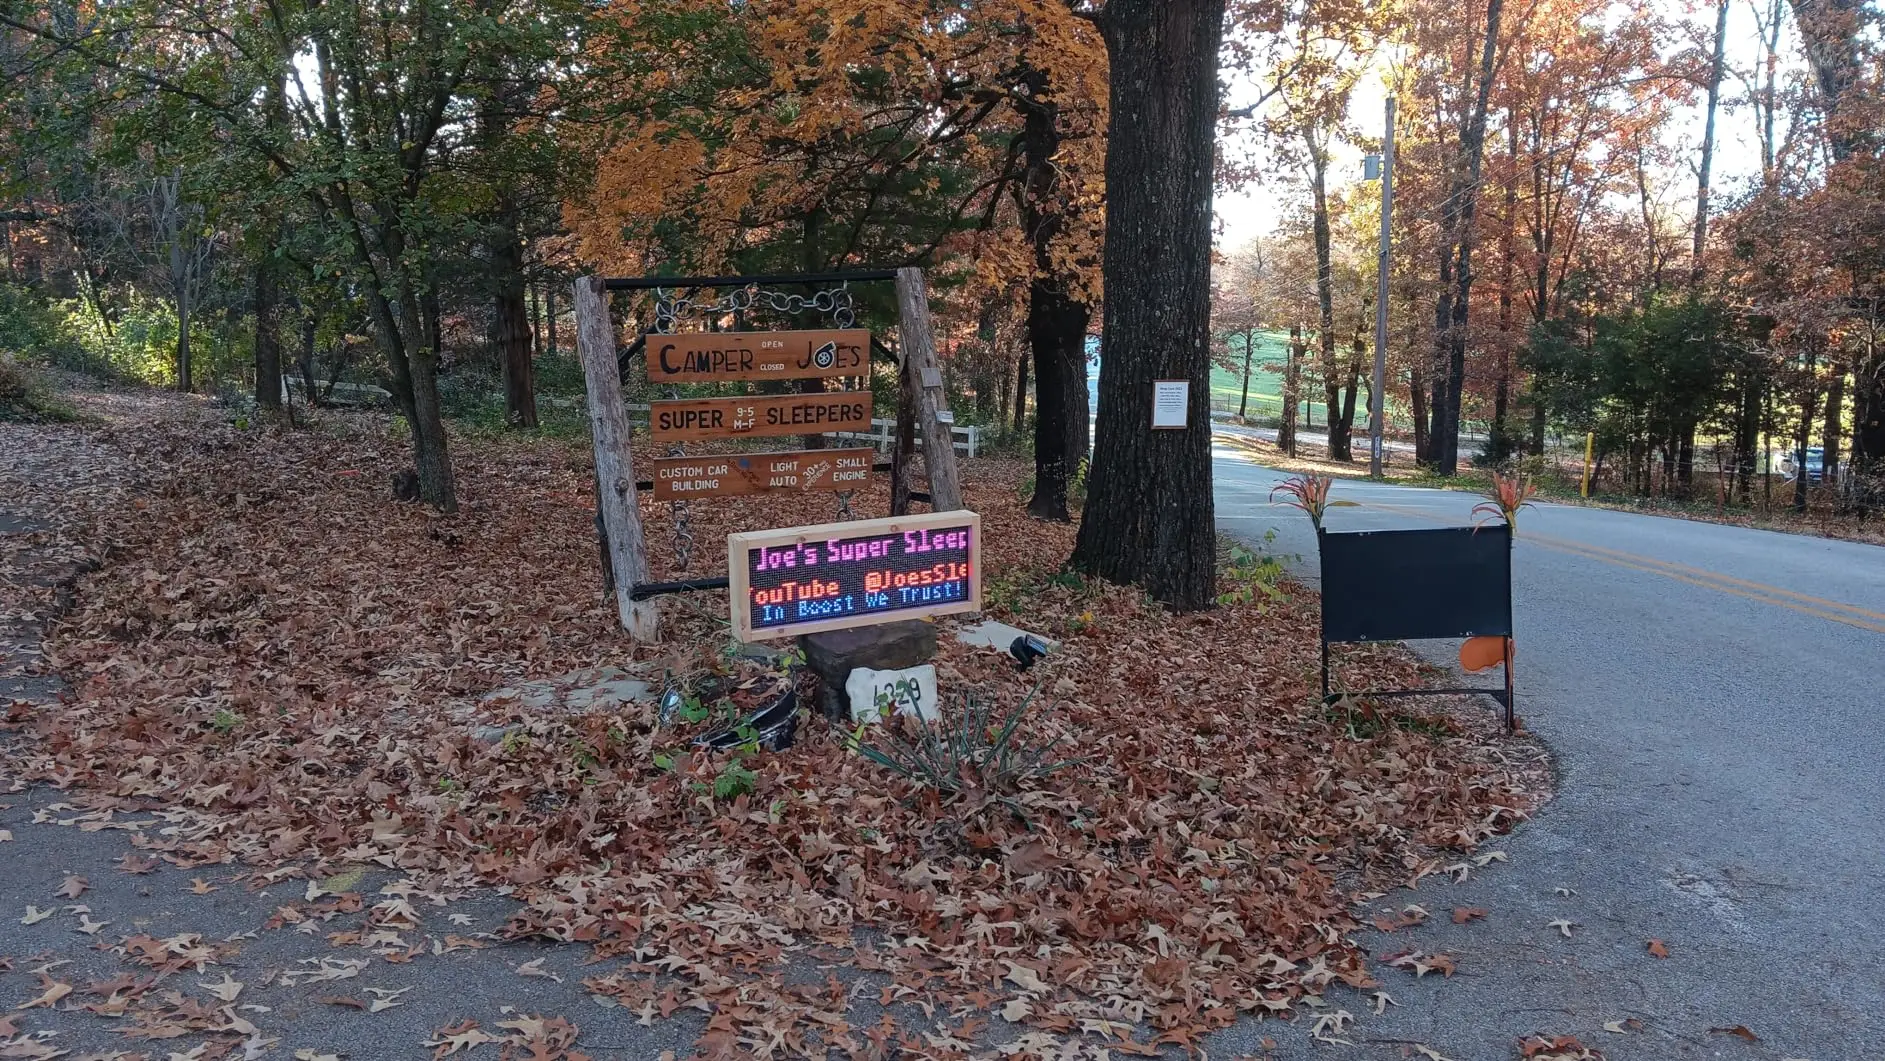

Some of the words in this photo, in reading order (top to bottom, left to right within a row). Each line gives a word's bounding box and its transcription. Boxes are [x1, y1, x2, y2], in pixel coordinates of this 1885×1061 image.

[761, 340, 784, 349] OPEN
[660, 344, 754, 374] CAMPER
[760, 363, 785, 372] CLOSED
[659, 409, 723, 431] SUPER
[767, 403, 864, 426] SLEEPERS
[736, 407, 755, 417] 9-5
[733, 419, 755, 430] M-F
[770, 462, 800, 473] LIGHT
[836, 457, 868, 469] SMALL
[659, 466, 703, 479] CUSTOM
[708, 465, 728, 476] CAR
[833, 470, 867, 482] ENGINE
[672, 479, 720, 492] BUILDING
[769, 476, 798, 487] AUTO
[756, 542, 818, 571] Joe's
[827, 538, 895, 562] Super
[749, 578, 840, 605] ouTube
[763, 604, 784, 621] In
[798, 594, 853, 617] Boost
[866, 591, 889, 607] We
[898, 580, 961, 603] Trust!
